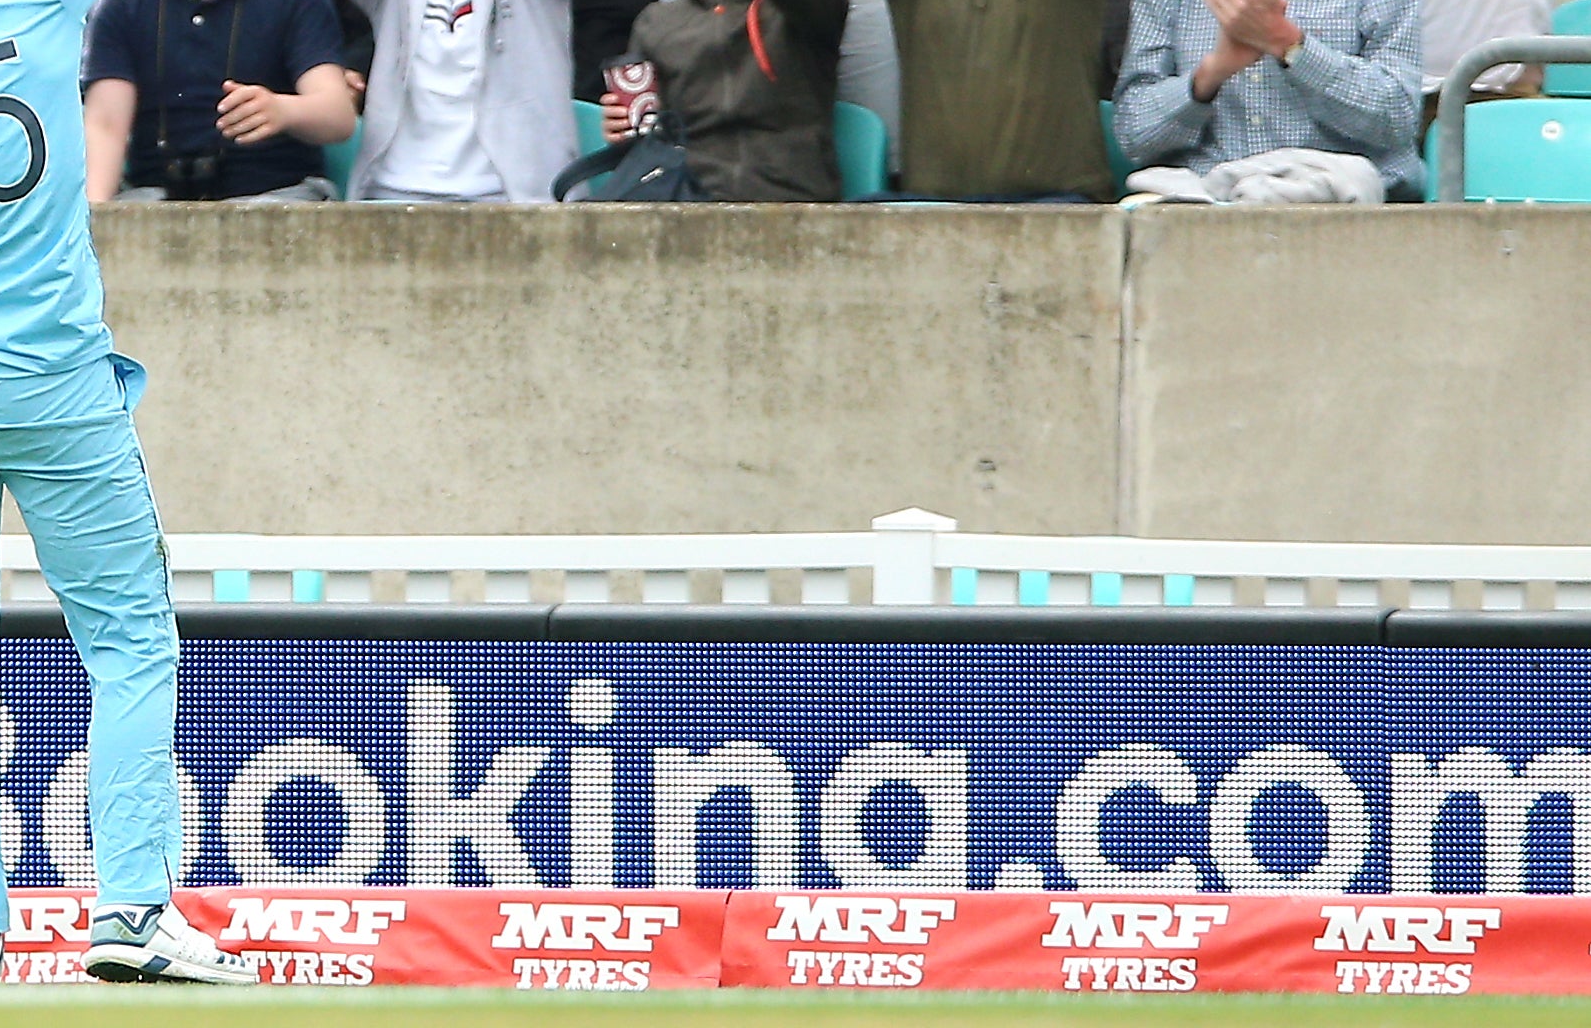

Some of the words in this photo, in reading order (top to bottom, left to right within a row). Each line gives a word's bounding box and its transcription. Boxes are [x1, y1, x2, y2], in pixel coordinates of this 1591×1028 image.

[219, 898, 406, 944] MRF
[491, 902, 680, 952] MRF
[766, 895, 956, 945] MRF
[1041, 901, 1230, 949] MRF
[1313, 905, 1502, 954] MRF
[2, 951, 100, 983] YRE
[240, 950, 375, 986] TYRES
[512, 957, 651, 991] TYRES
[787, 950, 925, 986] TYRES
[1061, 957, 1197, 991] TYRES
[1336, 960, 1473, 995] TYRES
